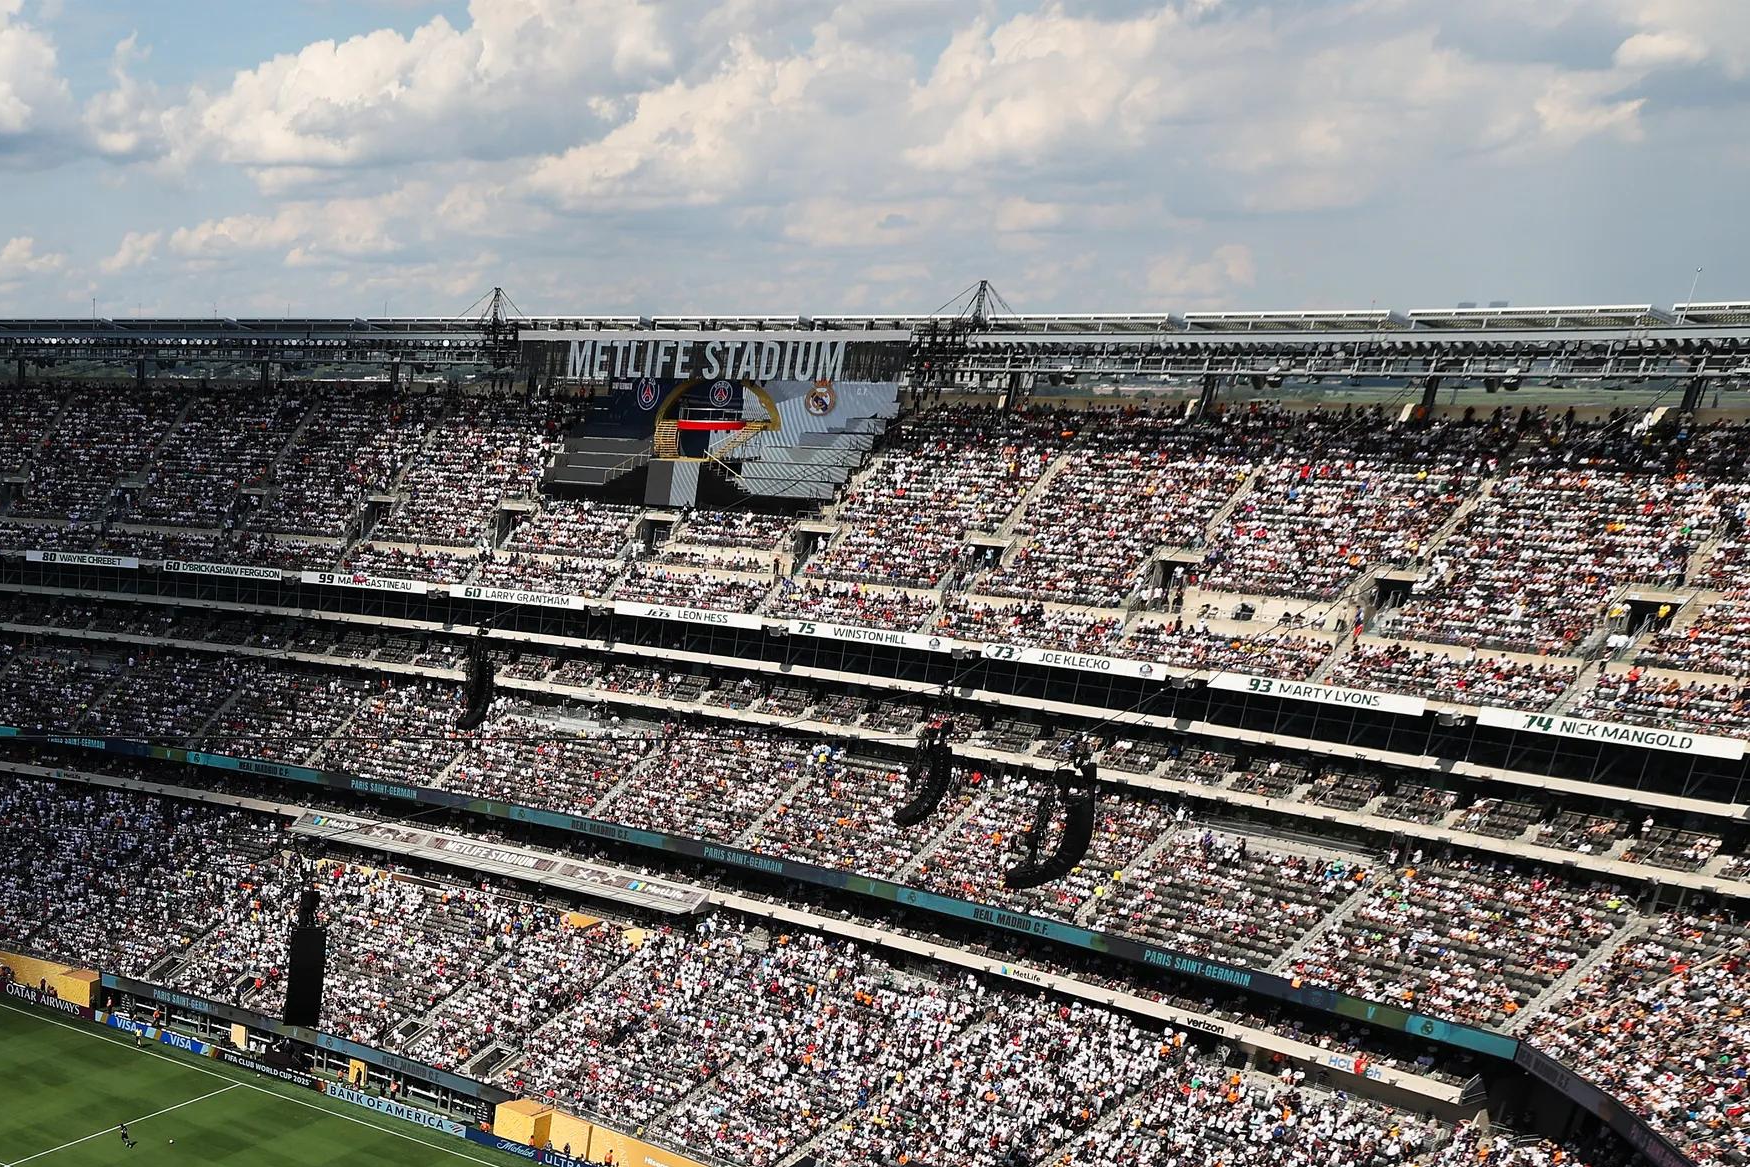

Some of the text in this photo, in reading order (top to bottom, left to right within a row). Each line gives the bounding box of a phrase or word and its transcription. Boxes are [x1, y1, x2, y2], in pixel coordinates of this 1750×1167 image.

[567, 339, 848, 381] METLIFE STADIUM
[42, 552, 122, 566] 80 WAYNE CHREBET
[165, 560, 280, 579] 60 D'BRICKASHAW FERGUSON
[318, 573, 412, 591] 99 GASTINEAU
[464, 586, 570, 606] 60 LARRY GRANTHAM
[677, 610, 703, 622] LEON
[703, 612, 729, 624] HESS
[797, 622, 907, 645] 75 WINSTON HILL
[992, 645, 1111, 671] 73 JOE KLECKO
[1246, 678, 1380, 707] 93 MARTY LYONS
[1522, 714, 1693, 749] 74 NICK MANGOLD
[239, 760, 254, 772] REAL
[255, 762, 278, 774] MADRID
[351, 778, 418, 800] PARIS SAINT-GERMAIN
[570, 819, 630, 841] REAL MADRID C.F.
[444, 840, 538, 869] METLIFE STADIUM
[703, 846, 784, 873] PARIS SAINT-GERMAIN
[644, 883, 684, 900] MetLife
[972, 907, 1050, 937] REAL MADRID C.F.
[1012, 968, 1041, 983] MetLife
[1143, 948, 1252, 988] PARIS SAINT-GERMAIN
[6, 983, 80, 1016] QATAR AIRWAYS
[153, 988, 219, 1015] PARIS SAINT-GERMAIN
[115, 1016, 137, 1032] VISA
[1186, 1016, 1226, 1036] verizon
[169, 1033, 192, 1051] VISA
[224, 1052, 238, 1065] FIFA
[238, 1056, 255, 1069] CLUB
[255, 1060, 279, 1076] WORLD
[279, 1067, 293, 1081] CUP
[381, 1055, 441, 1083] REAL MADRID C.F.
[330, 1085, 445, 1130] BANK OF AMERICA
[496, 1138, 536, 1159] Michelob
